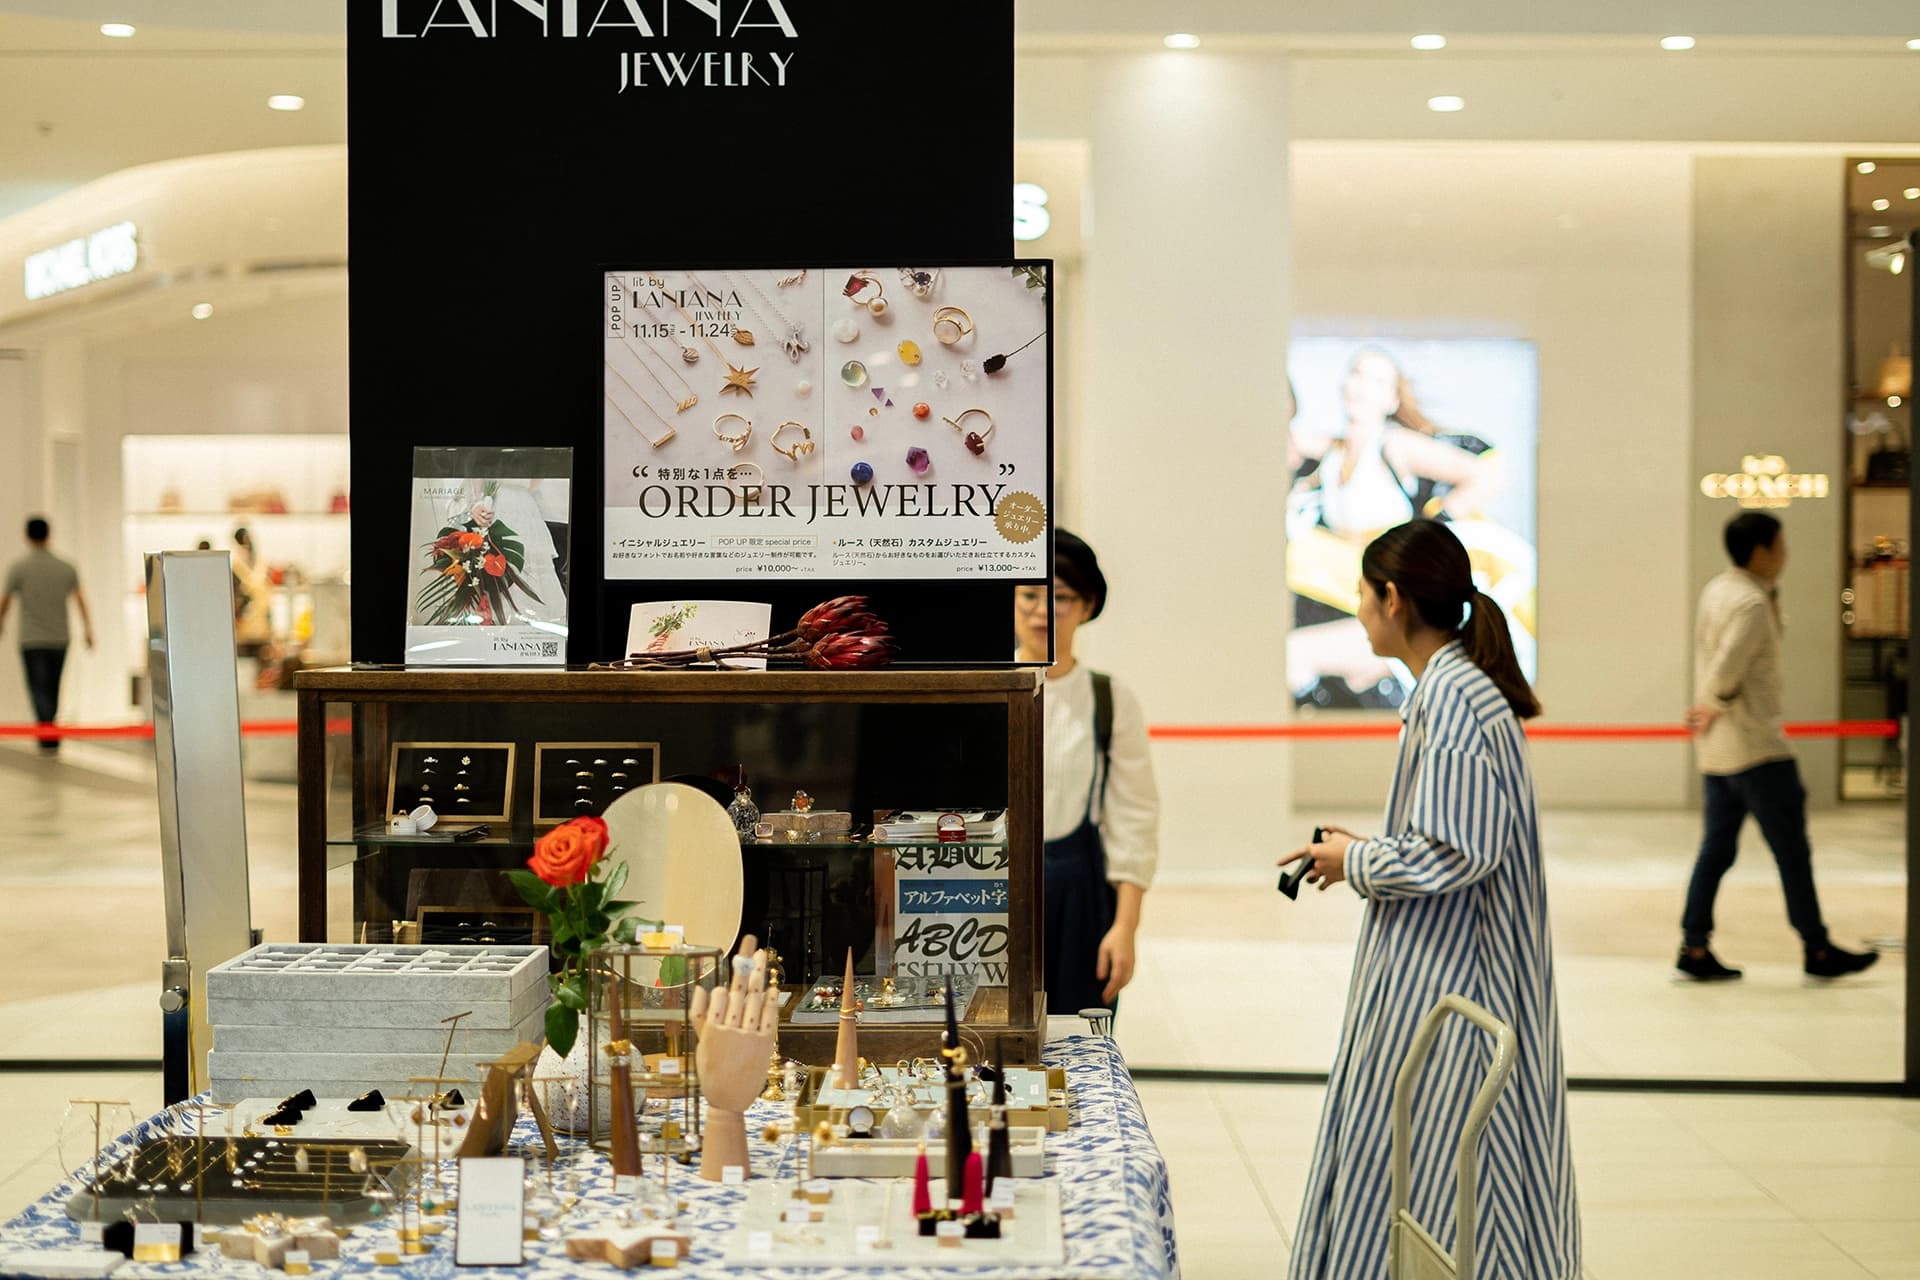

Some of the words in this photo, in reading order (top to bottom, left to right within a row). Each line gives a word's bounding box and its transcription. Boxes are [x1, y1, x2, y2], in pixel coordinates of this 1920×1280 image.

[617, 52, 795, 94] JEWELRY
[632, 277, 645, 287] lit
[648, 276, 665, 289] by
[611, 284, 622, 301] UP
[632, 290, 743, 309] LANTANA
[611, 305, 622, 331] POP
[632, 323, 669, 338] 11.15
[689, 323, 730, 338] 11.24
[423, 487, 465, 496] MARIAGE
[638, 484, 797, 519] ORDER
[806, 483, 1008, 525] JEWELRY
[718, 537, 735, 546] POP
[736, 537, 748, 546] UP
[764, 537, 791, 549] special
[792, 538, 812, 549] price
